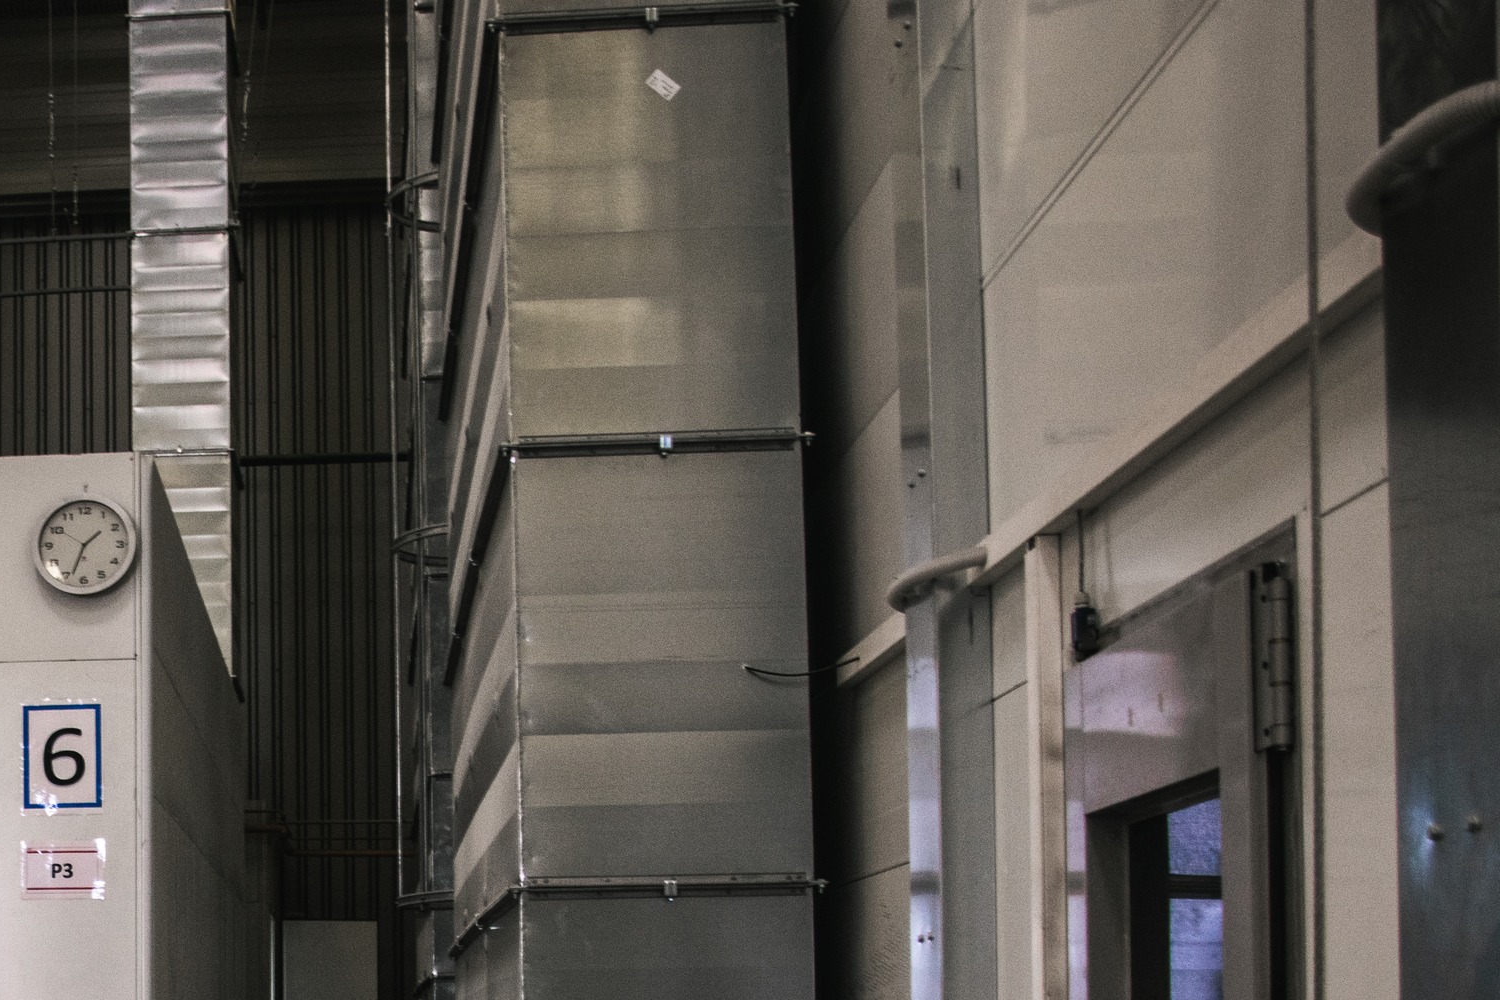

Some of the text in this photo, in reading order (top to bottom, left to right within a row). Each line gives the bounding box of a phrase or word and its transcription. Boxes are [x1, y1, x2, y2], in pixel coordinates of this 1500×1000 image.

[78, 506, 92, 515] 12
[62, 512, 74, 521] 11
[50, 526, 64, 535] 10
[110, 523, 120, 532] 2
[44, 542, 54, 551] 9
[115, 540, 125, 549] 3
[110, 557, 119, 566] 4
[62, 571, 71, 579] 7
[97, 570, 107, 579] 5
[79, 576, 89, 585] 6
[43, 727, 86, 786] 6
[51, 863, 74, 879] P3
